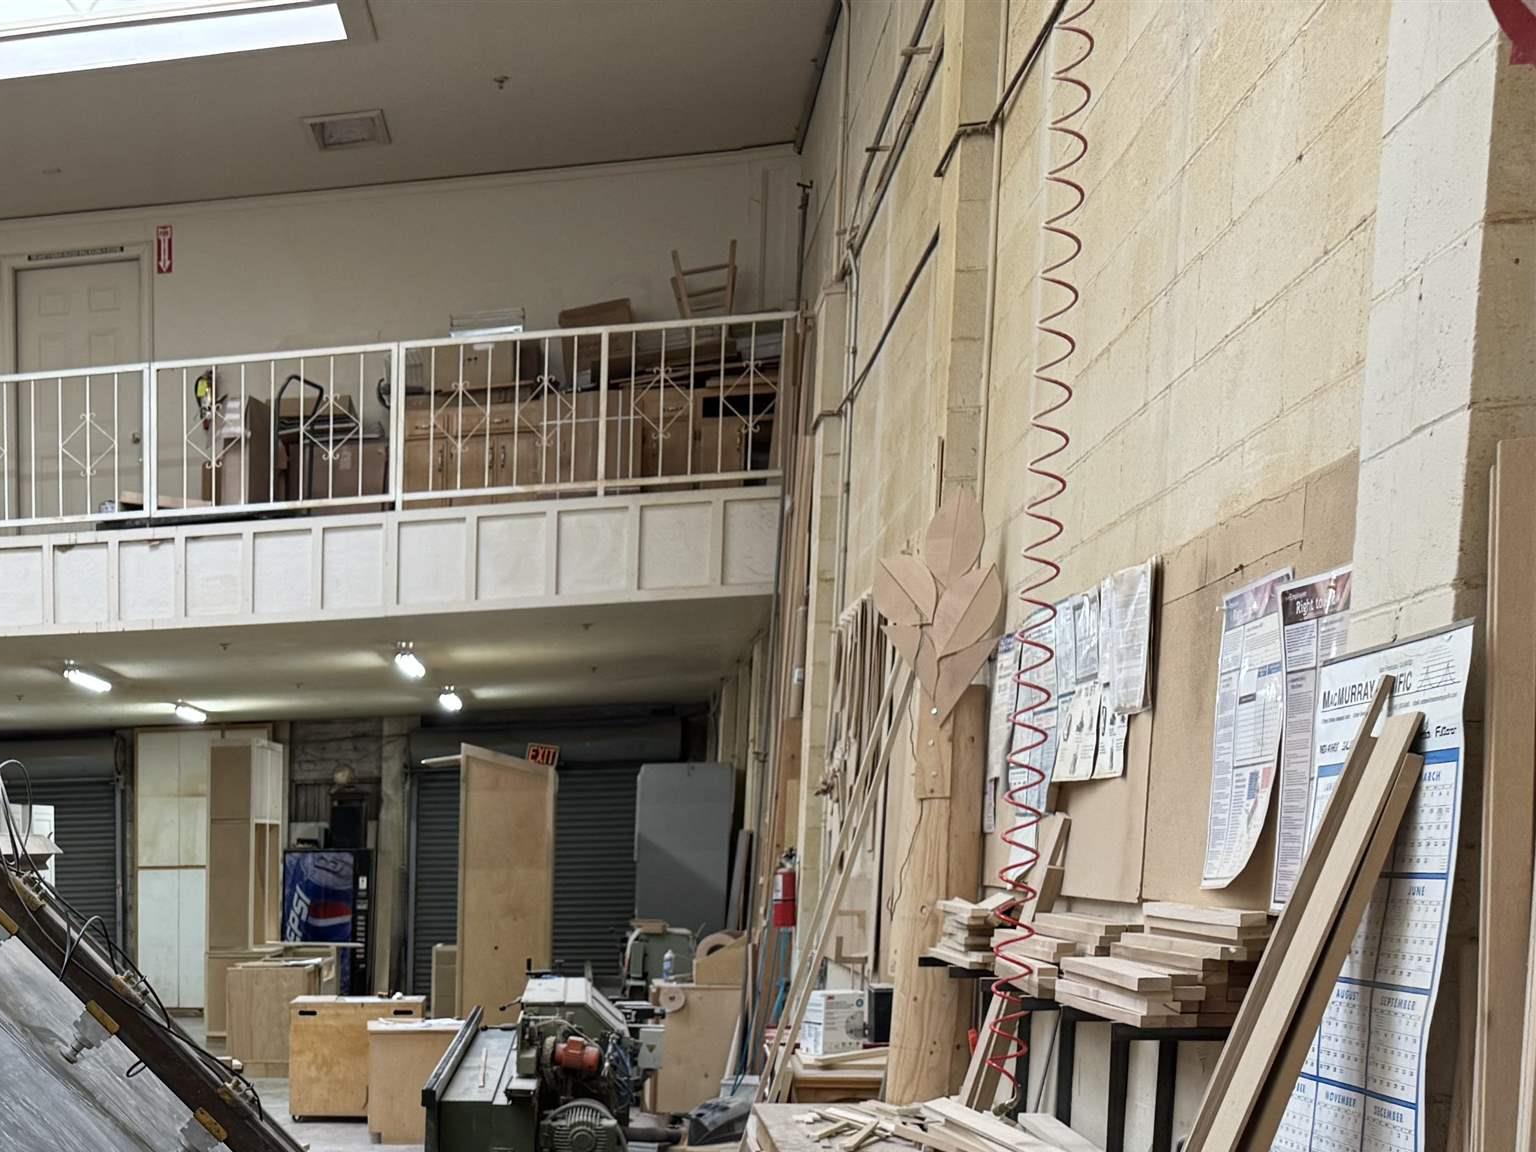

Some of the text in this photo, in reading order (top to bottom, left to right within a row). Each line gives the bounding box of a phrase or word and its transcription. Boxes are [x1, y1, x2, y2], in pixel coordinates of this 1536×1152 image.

[1296, 599, 1314, 616] Right
[528, 745, 556, 766] EXIT
[1408, 886, 1426, 897] JUNE
[285, 884, 311, 943] EPSI
[1336, 988, 1360, 1001] AUGUST
[1379, 995, 1416, 1011] SEPTEMBER
[1325, 1091, 1357, 1109] NOVEMBER
